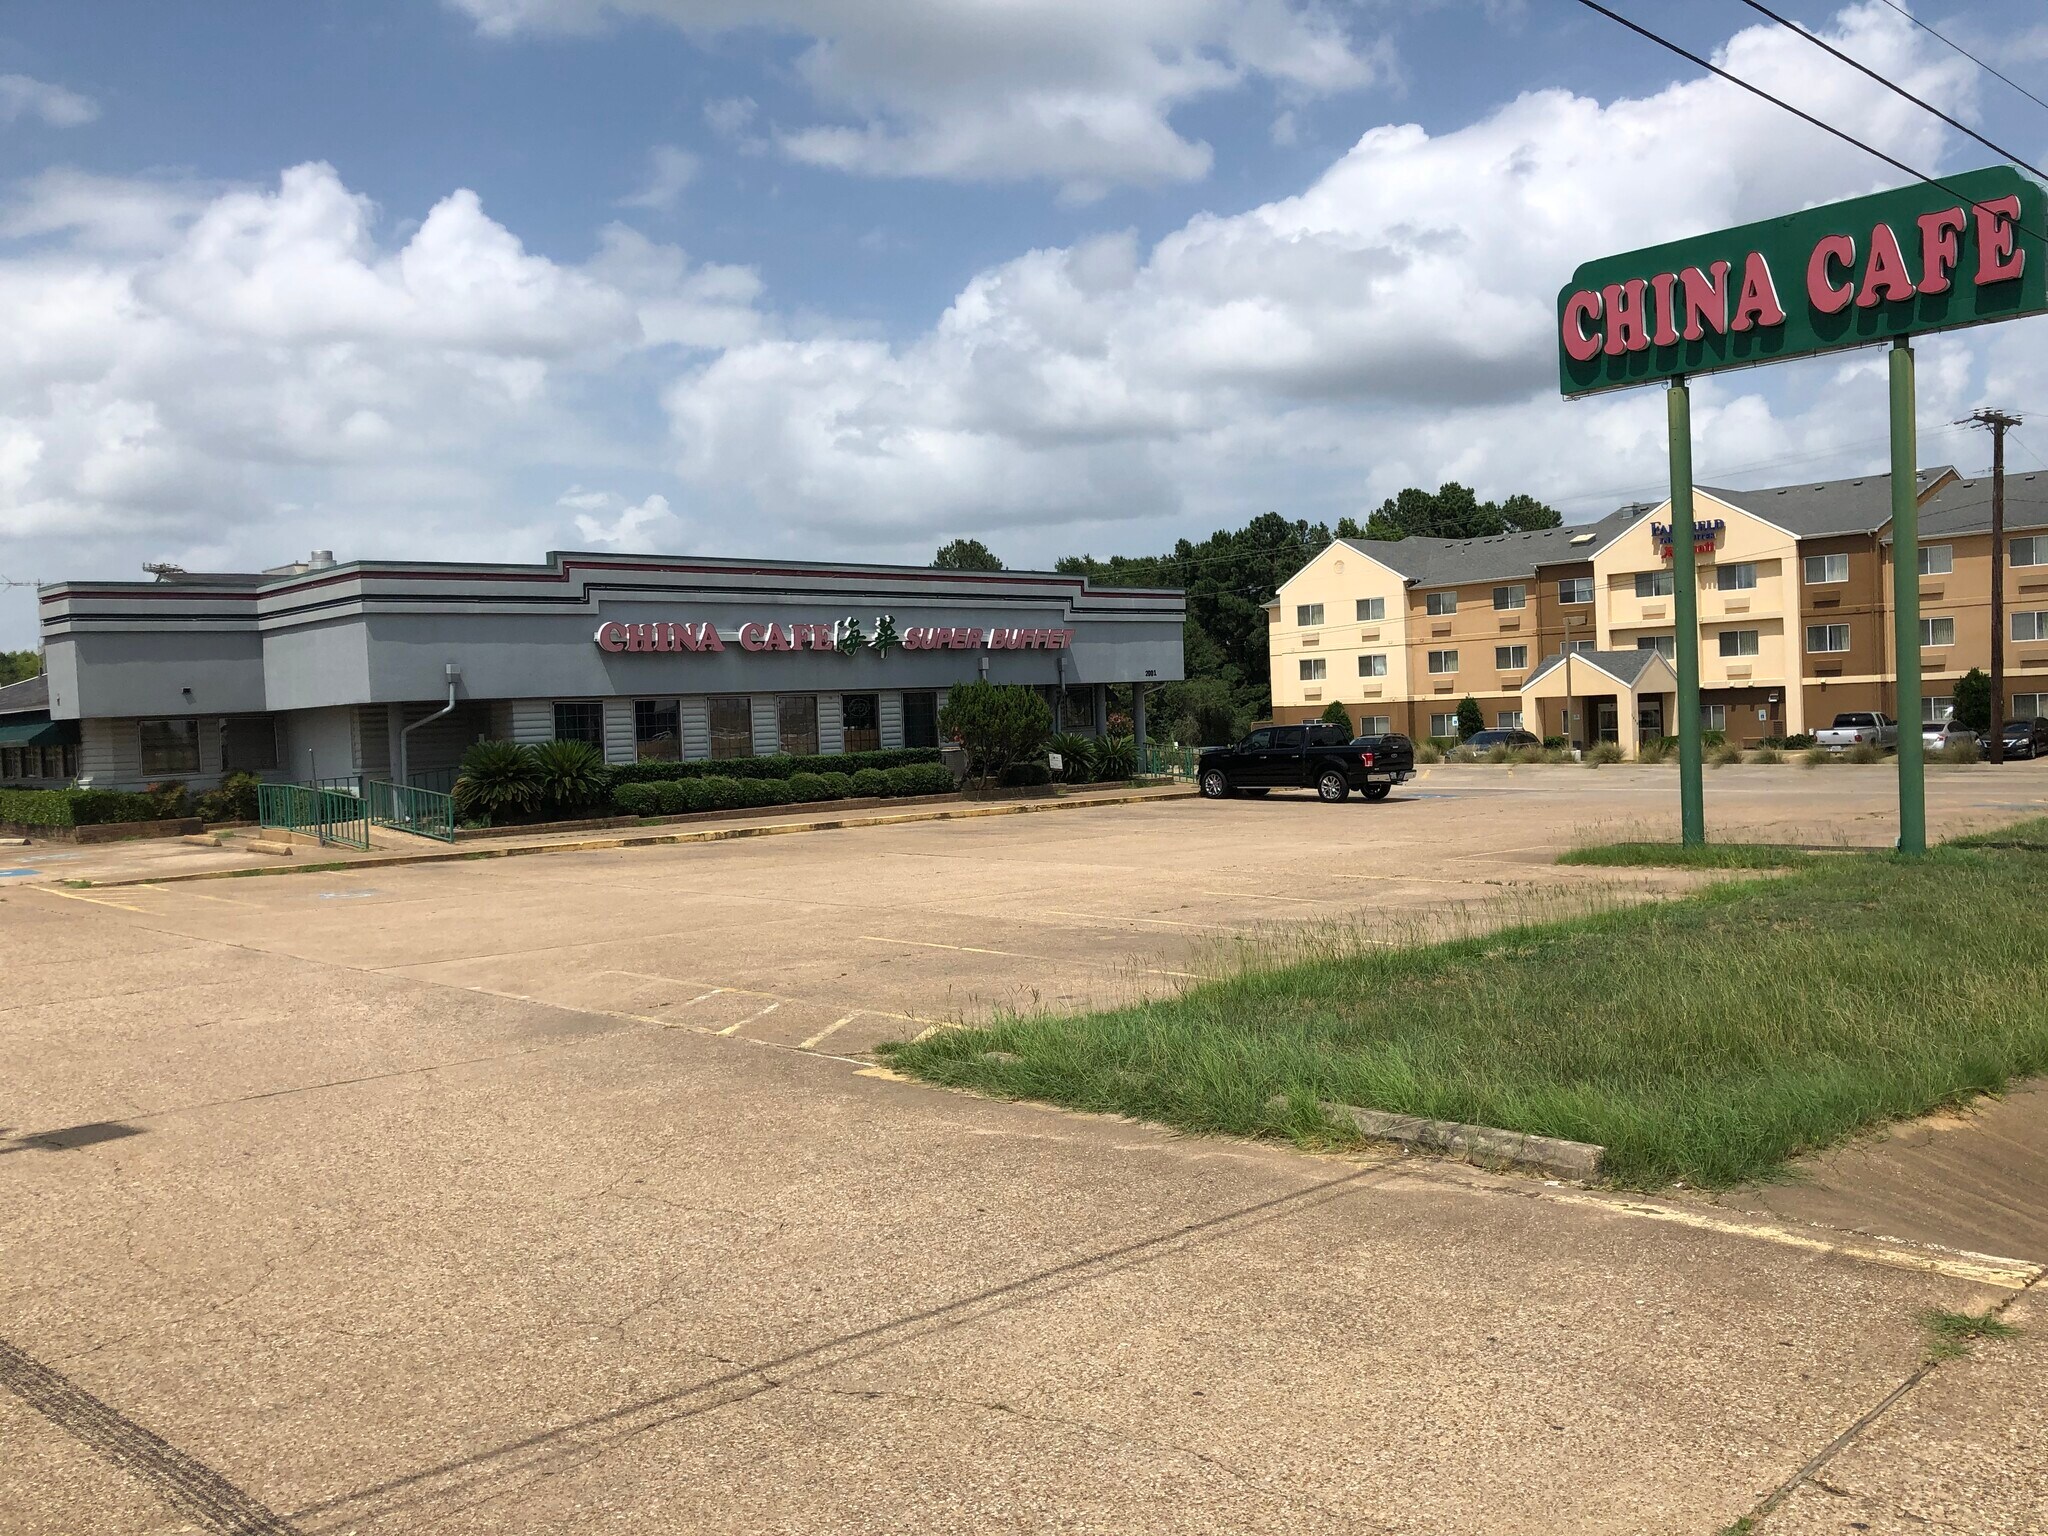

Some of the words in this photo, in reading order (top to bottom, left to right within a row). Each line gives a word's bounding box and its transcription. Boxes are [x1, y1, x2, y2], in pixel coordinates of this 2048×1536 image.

[1562, 251, 1787, 361] CHINA
[1806, 194, 2026, 314] CAFE
[598, 621, 726, 652] CHINA
[738, 622, 834, 652] CAFE
[902, 626, 984, 650] SUPER
[987, 628, 1076, 650] BUFFET
